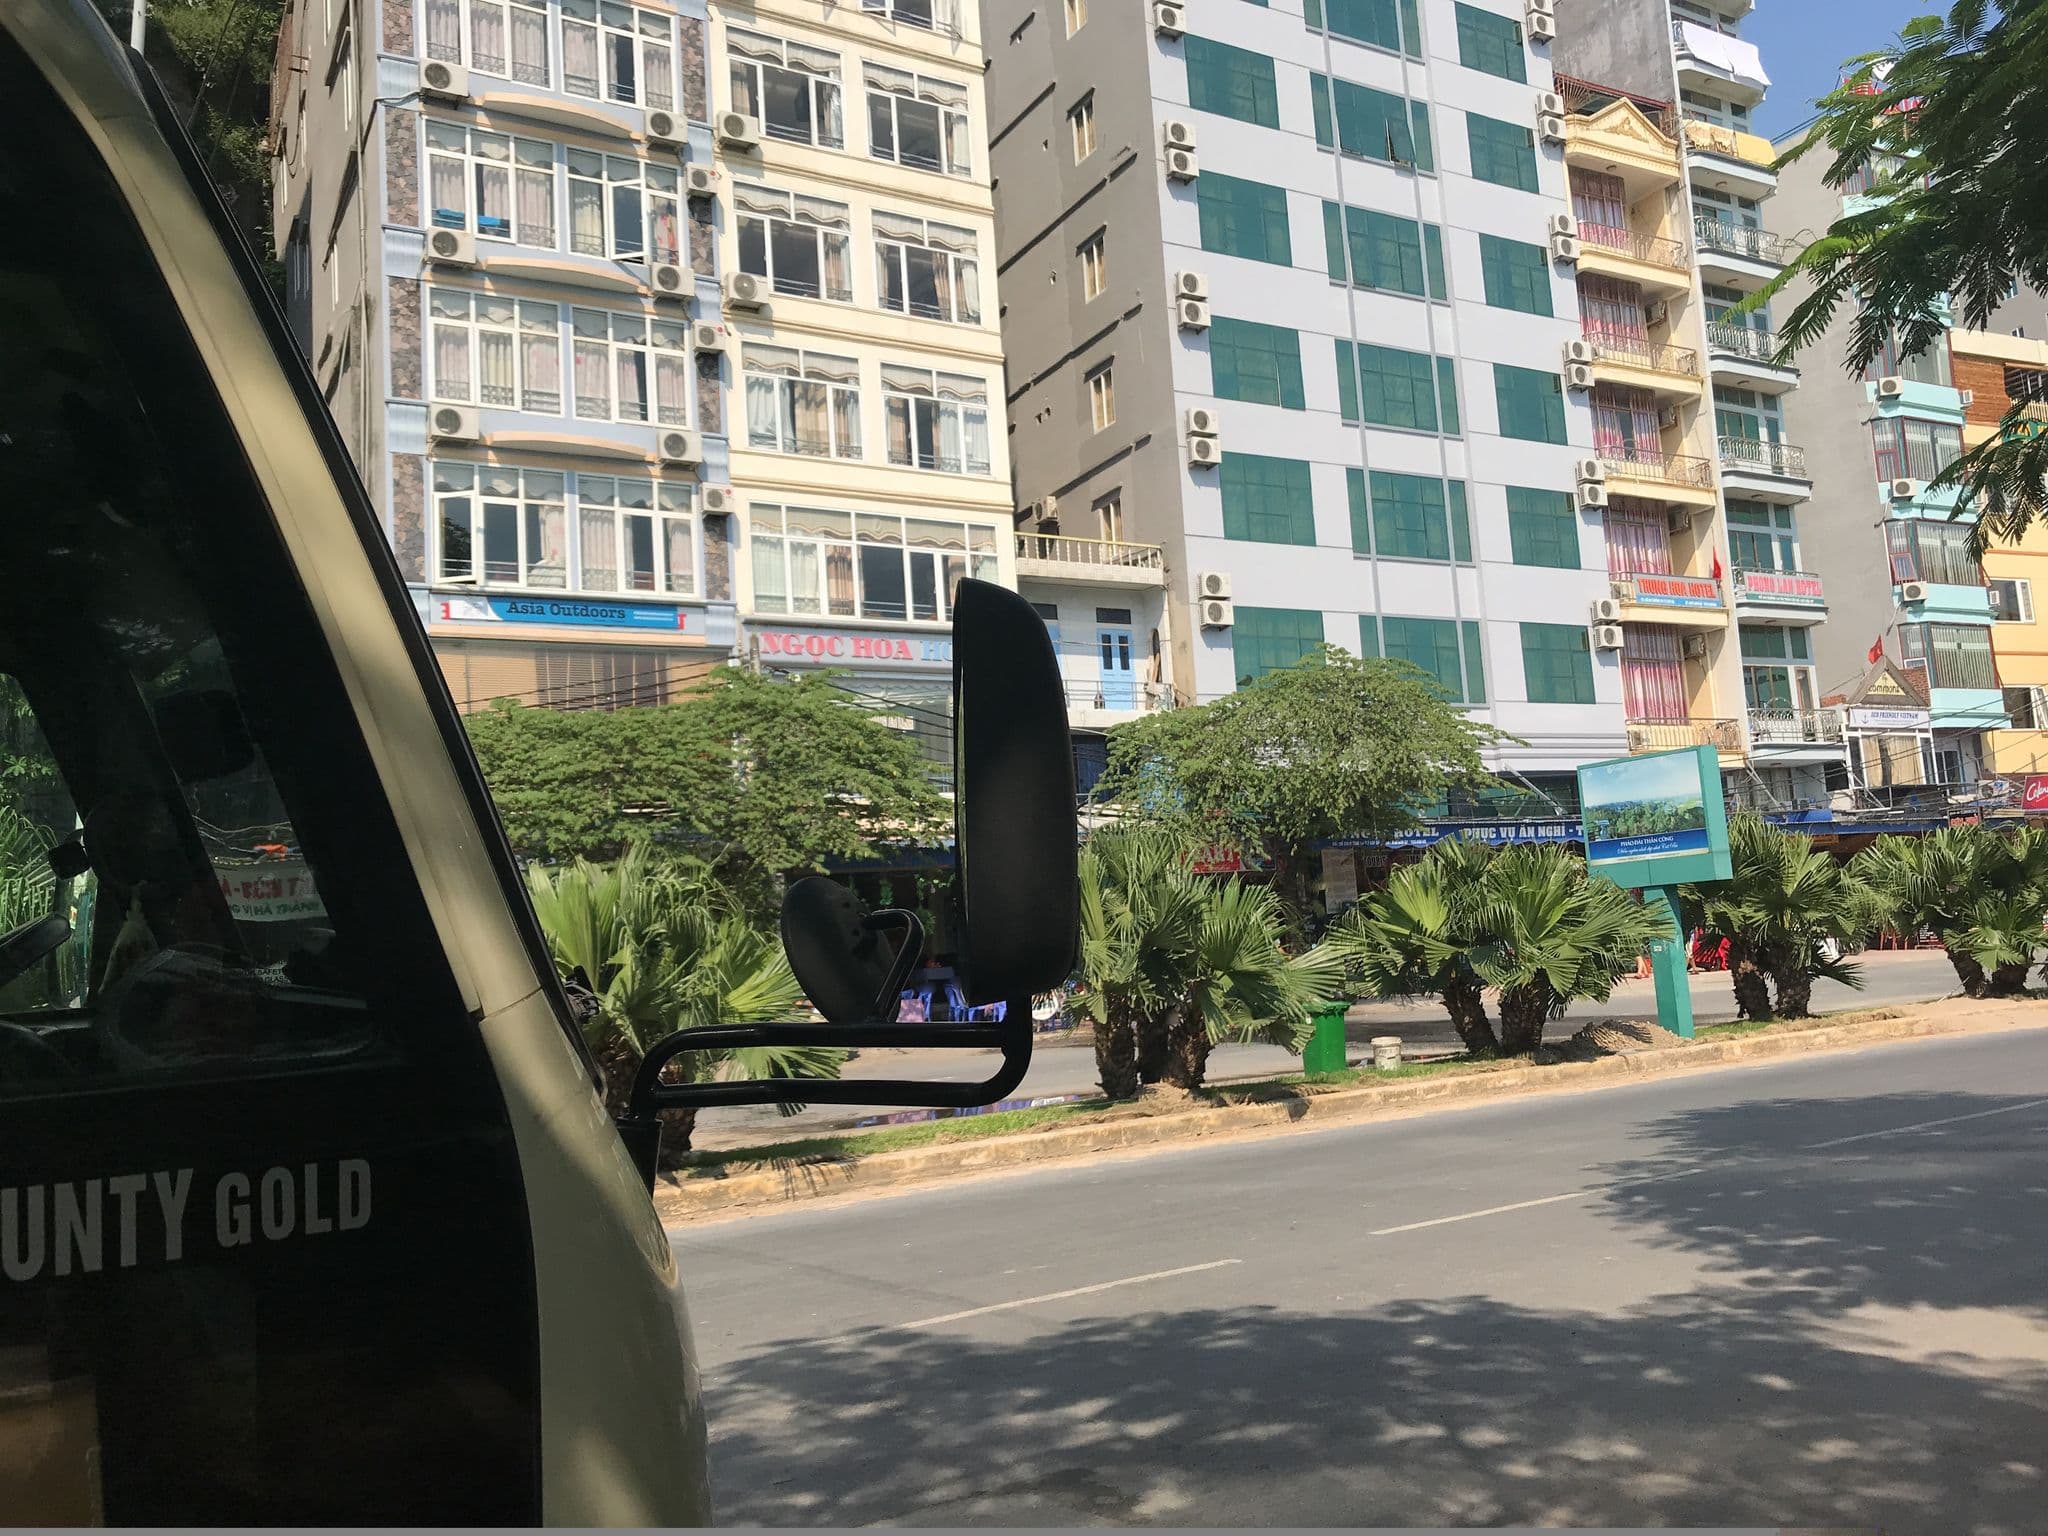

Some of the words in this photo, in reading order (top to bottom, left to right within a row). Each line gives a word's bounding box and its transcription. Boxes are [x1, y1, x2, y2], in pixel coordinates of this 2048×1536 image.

[1689, 582, 1716, 599] HOTEL
[1795, 579, 1823, 597] HOTEL
[507, 601, 544, 616] Asia
[550, 602, 625, 619] Outdoors
[760, 631, 845, 663] NGỌC
[850, 636, 913, 661] HOA
[0, 1167, 194, 1282] UNTY
[215, 1158, 372, 1248] GOLD
